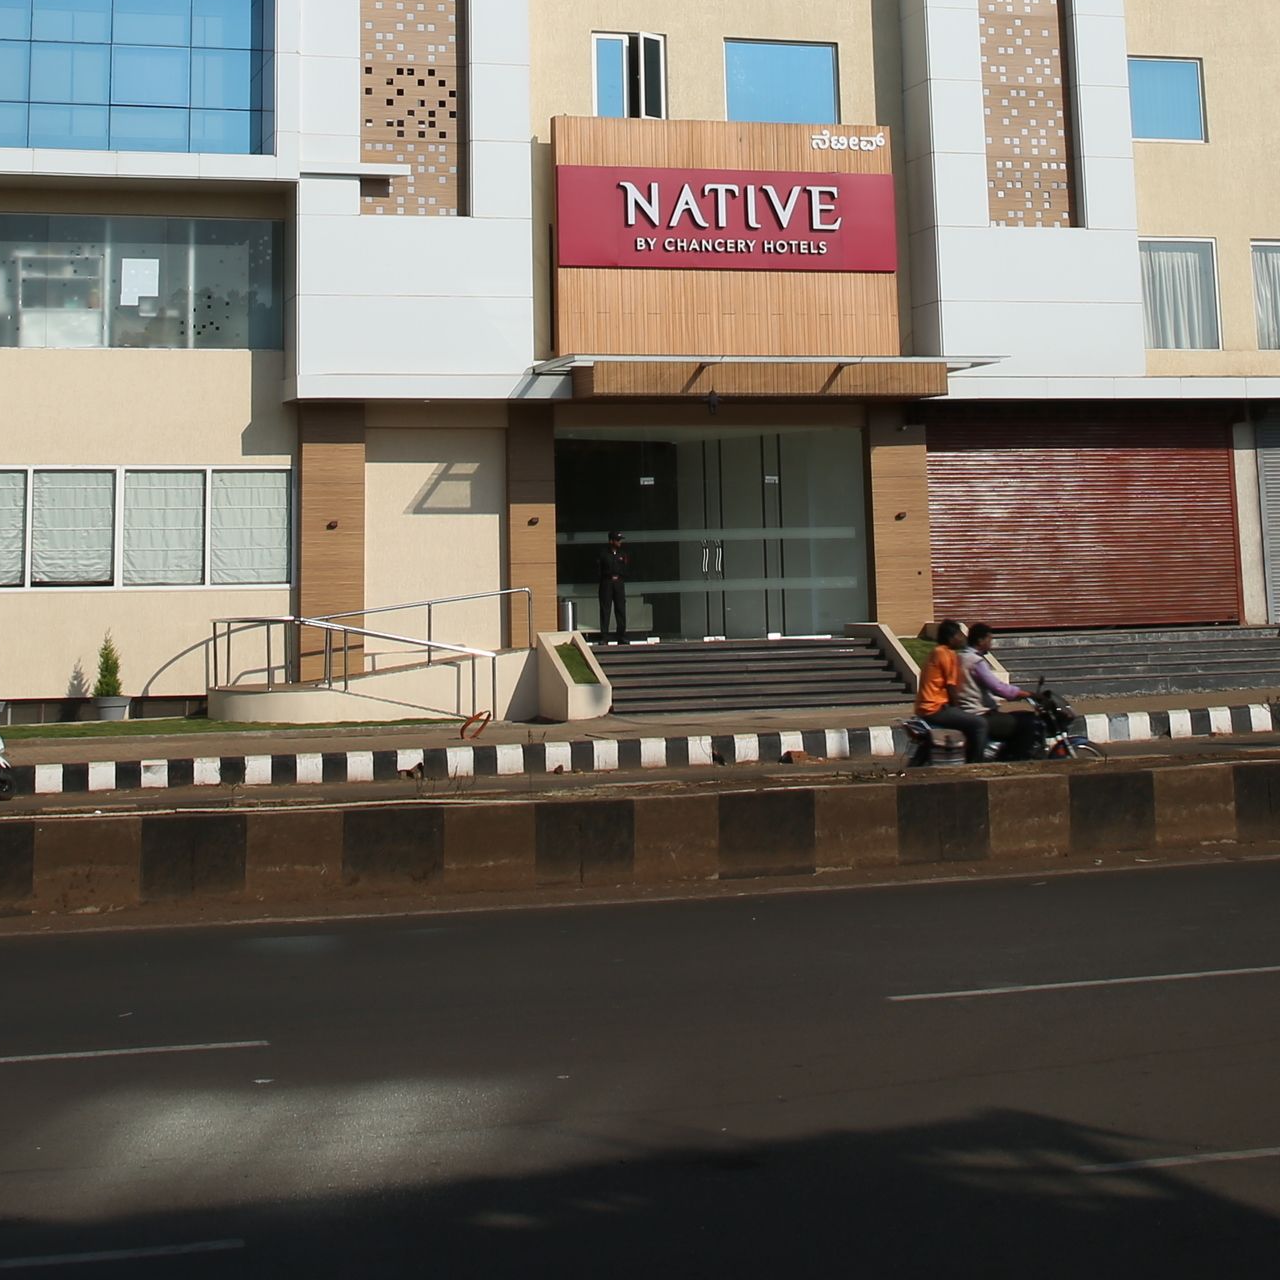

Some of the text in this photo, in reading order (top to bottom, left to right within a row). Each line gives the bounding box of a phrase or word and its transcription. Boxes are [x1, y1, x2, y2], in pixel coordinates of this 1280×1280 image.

[619, 181, 843, 231] NATIVE
[636, 237, 828, 254] BY CHANCERY HOTELS
